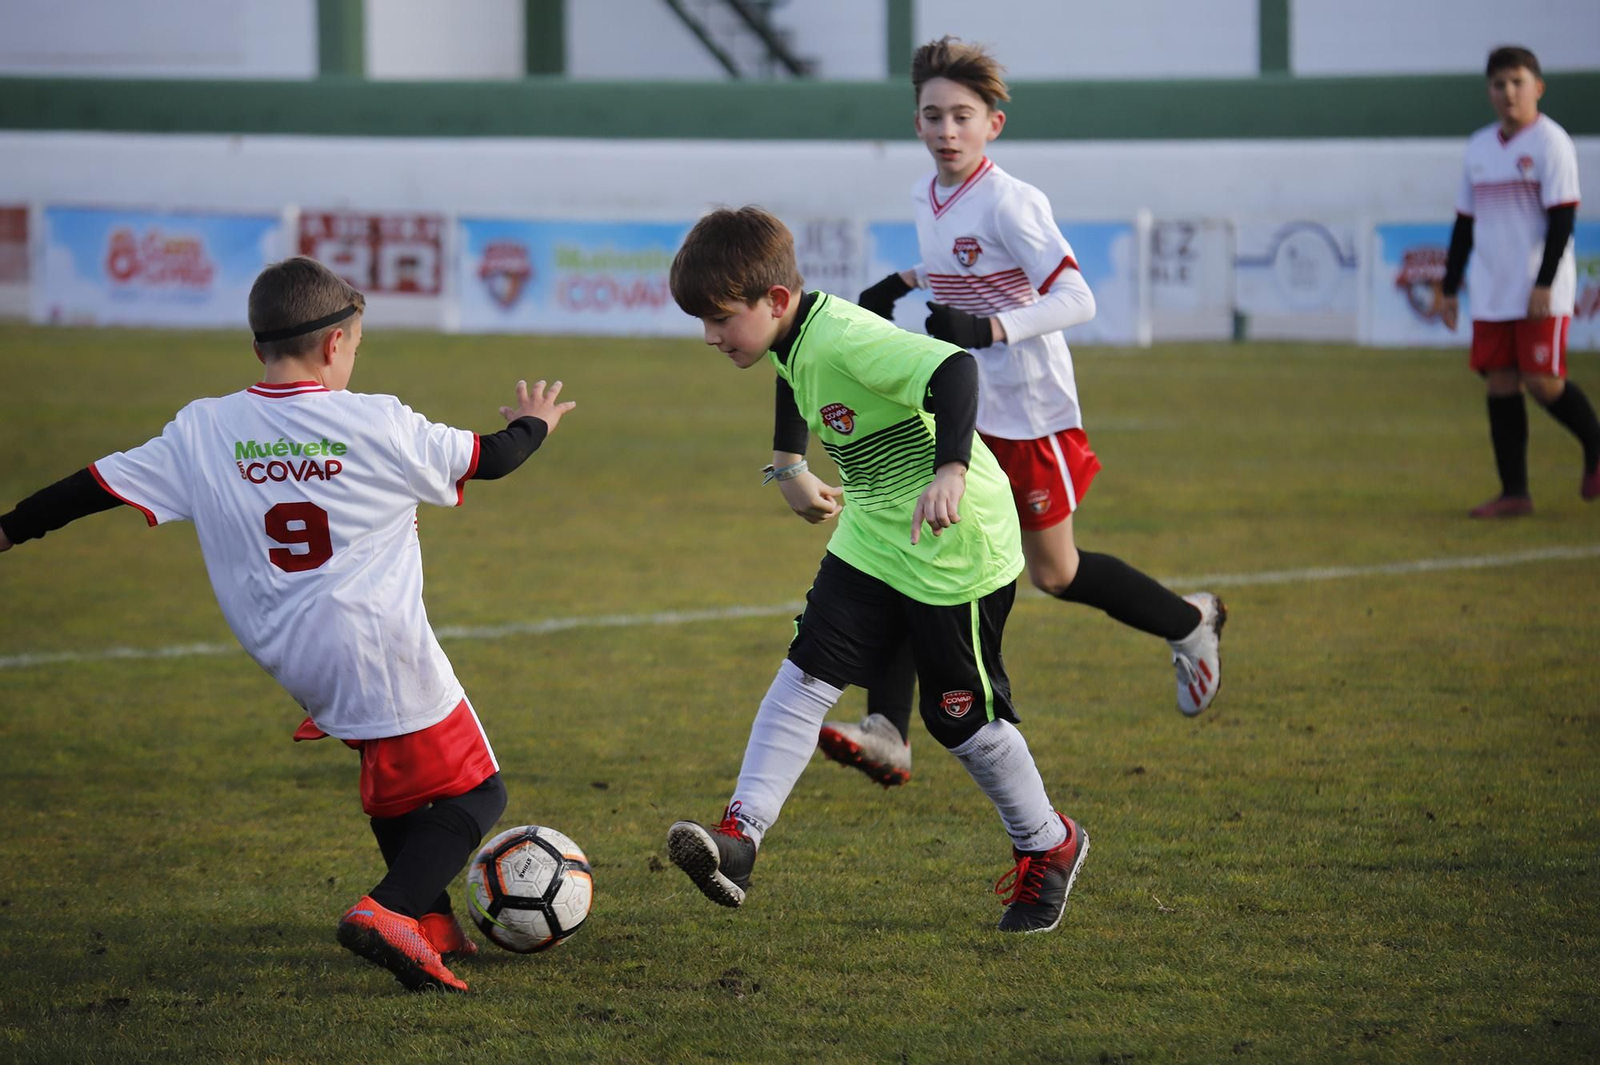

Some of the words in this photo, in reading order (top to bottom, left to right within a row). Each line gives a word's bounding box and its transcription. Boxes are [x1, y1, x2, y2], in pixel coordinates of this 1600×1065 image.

[234, 438, 347, 460] Muévete
[246, 460, 342, 484] COVAP
[264, 501, 333, 573] 9
[945, 695, 971, 704] COVAP
[519, 857, 532, 879] STRIKE
